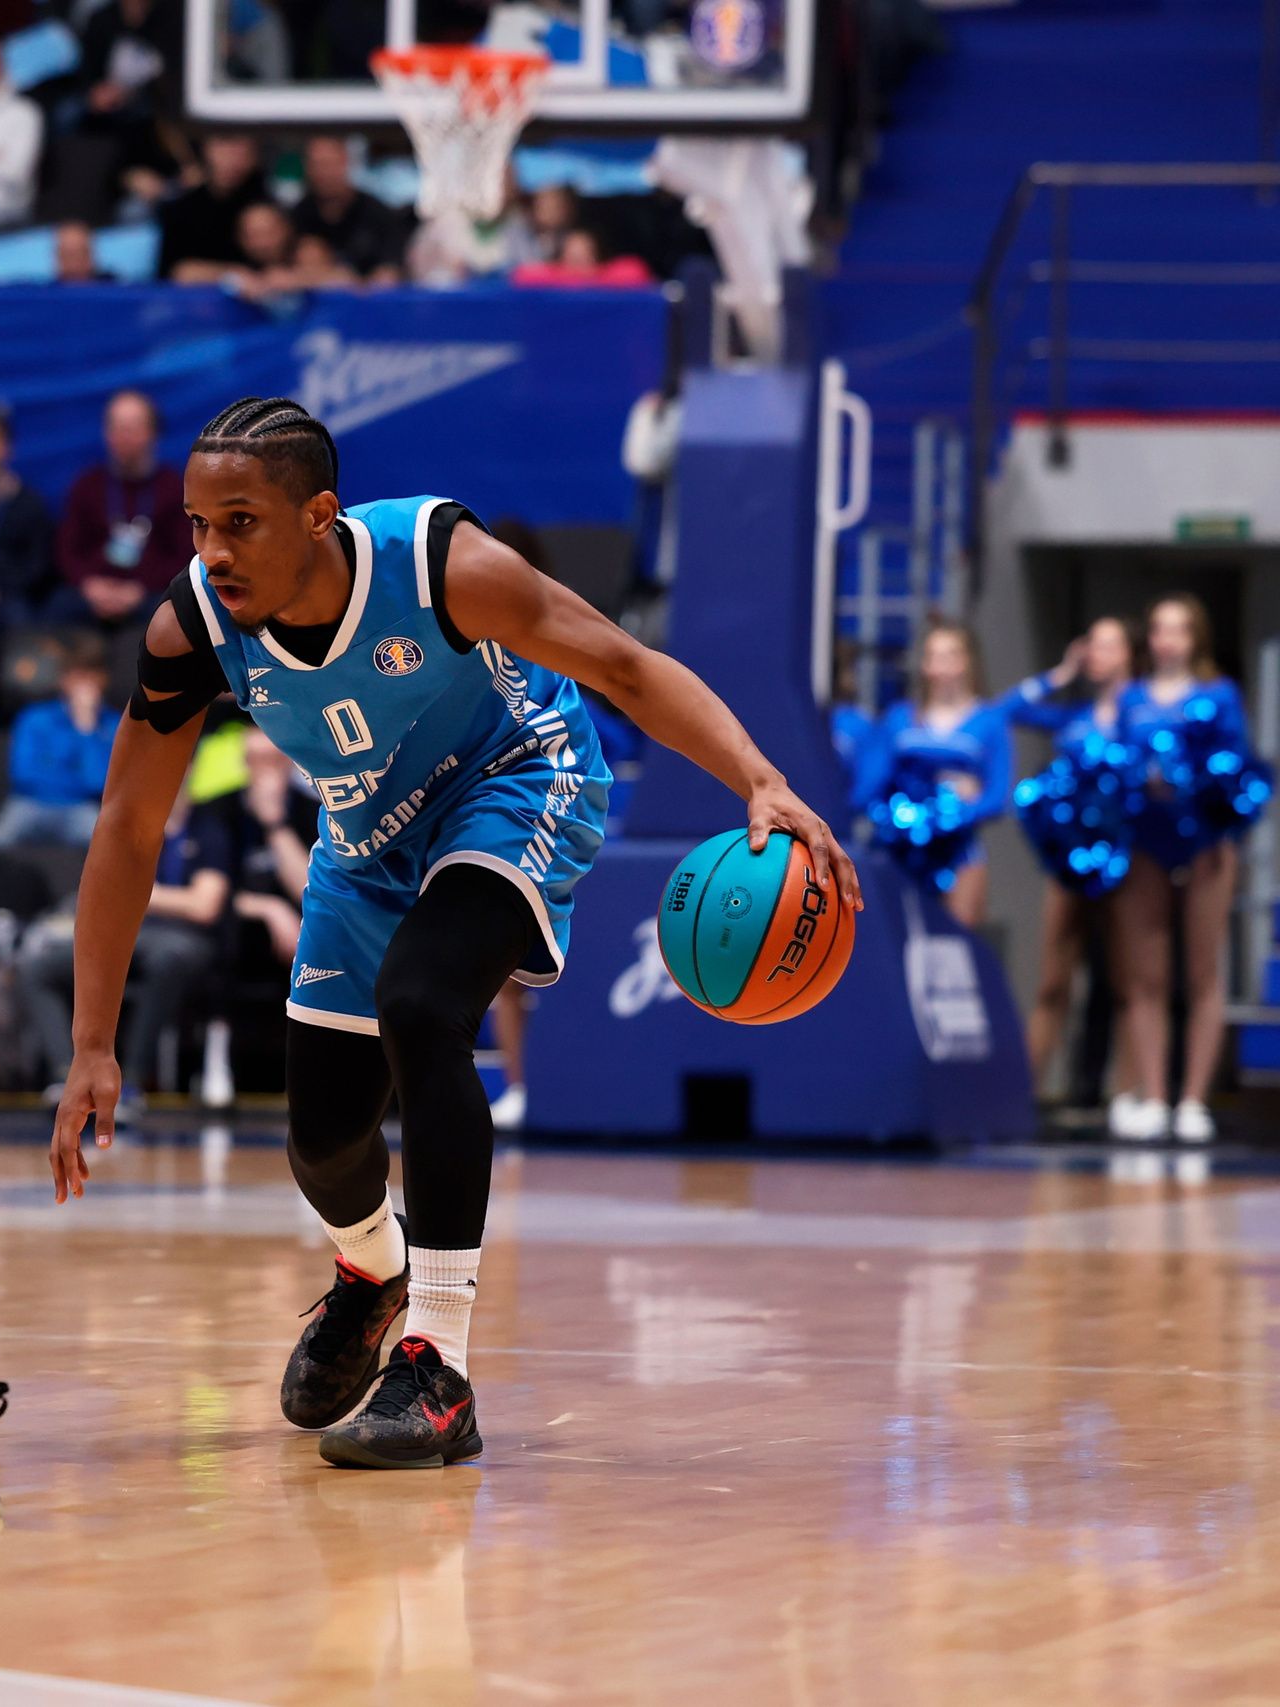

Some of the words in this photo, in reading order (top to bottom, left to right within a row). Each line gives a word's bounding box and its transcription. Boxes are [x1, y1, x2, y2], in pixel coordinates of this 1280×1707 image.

[322, 698, 374, 757] 0
[672, 871, 696, 912] FIBA
[765, 865, 828, 983] JÖGEL
[295, 963, 345, 988] Зенит
